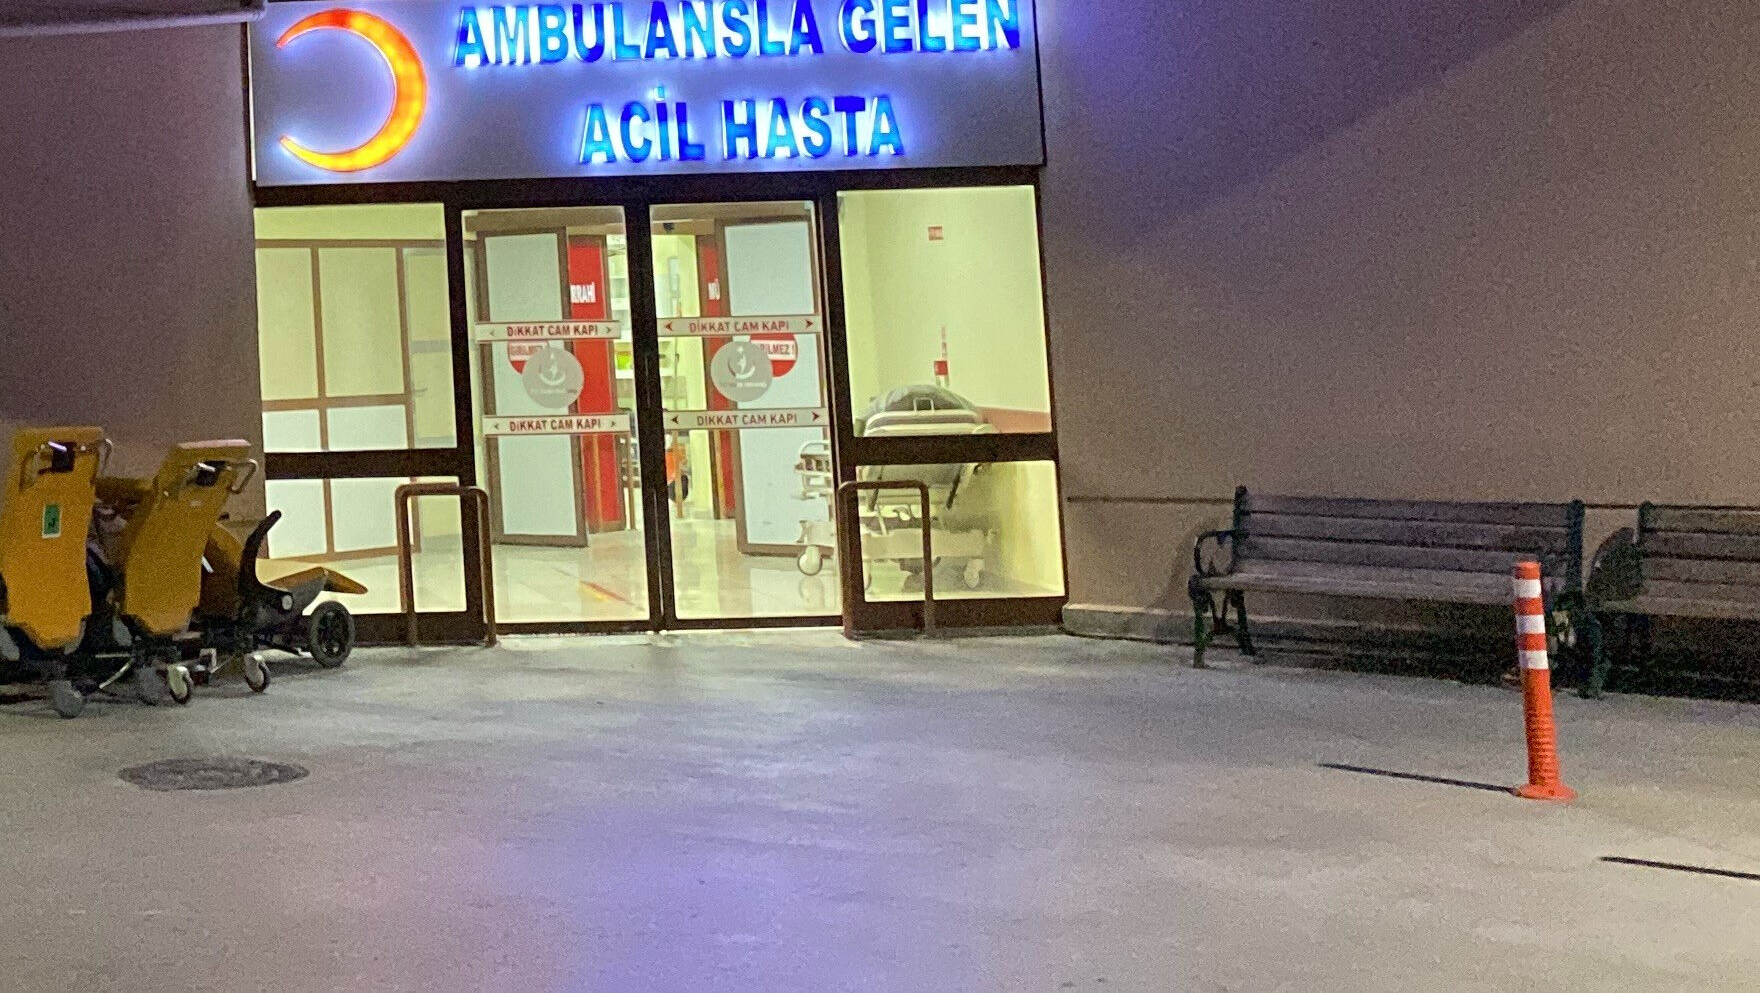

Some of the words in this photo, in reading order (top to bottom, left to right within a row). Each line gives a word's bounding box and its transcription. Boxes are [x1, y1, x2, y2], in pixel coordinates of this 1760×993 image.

[579, 85, 706, 163] ACİL
[721, 95, 904, 159] HASTA
[548, 325, 571, 335] CAM
[574, 324, 598, 335] KAPI
[734, 320, 759, 332] CAM
[762, 320, 790, 330] KAPI
[551, 420, 574, 431] CAM
[577, 419, 601, 430] KAPI
[742, 415, 767, 425] CAM
[770, 414, 798, 425] KAPI
